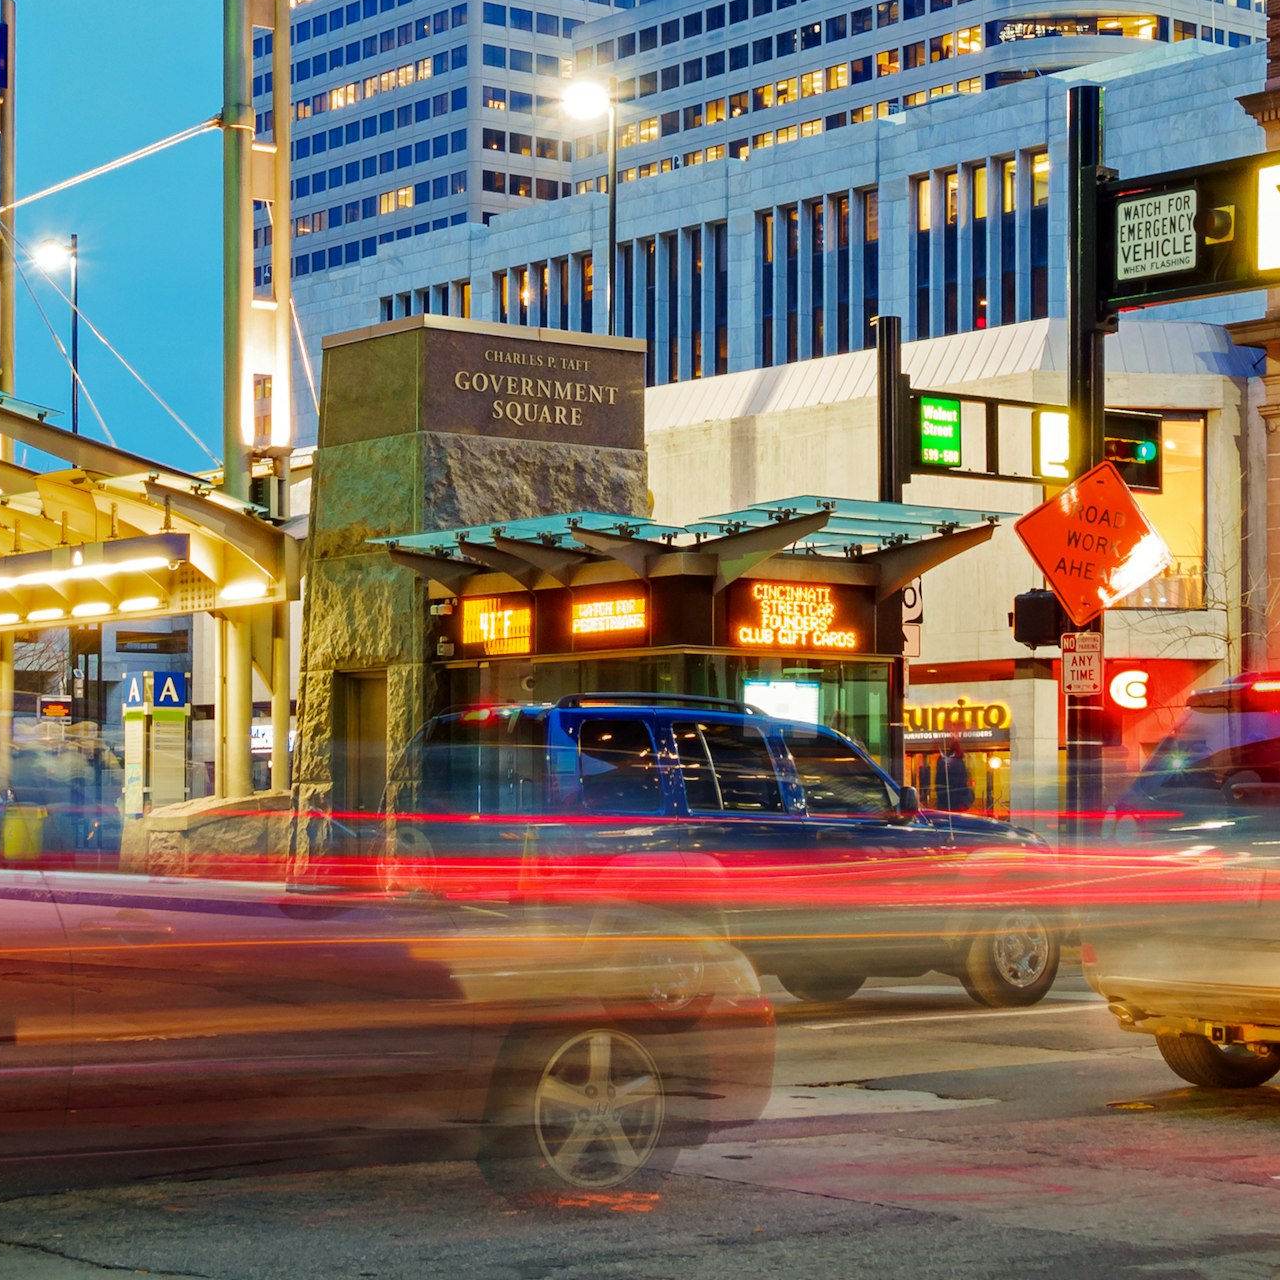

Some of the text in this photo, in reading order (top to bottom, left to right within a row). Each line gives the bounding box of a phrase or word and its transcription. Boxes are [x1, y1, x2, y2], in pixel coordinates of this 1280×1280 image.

[1123, 195, 1191, 221] WATCH FOR
[1120, 212, 1194, 243] EMERGENCY
[1121, 234, 1193, 264] VEHICLE
[1123, 256, 1191, 275] WHEN FLASHING
[484, 349, 591, 372] CHARLES P. TAFT
[454, 370, 619, 405] GOVERNMENT
[492, 399, 583, 426] SQUARE
[922, 405, 958, 423] Walnut
[923, 421, 954, 438] Street
[1071, 503, 1127, 529] ROAD
[1067, 529, 1121, 558] WORK
[1054, 557, 1114, 586] AHEA
[753, 584, 831, 603] CINCINNATI
[761, 600, 835, 618] STREETCAR
[739, 627, 856, 648] CLUB GIFT CARDS
[1063, 637, 1076, 650] NO
[1071, 655, 1093, 667] ANY
[1070, 669, 1095, 681] TIME
[128, 676, 141, 703] A
[159, 676, 180, 703] A
